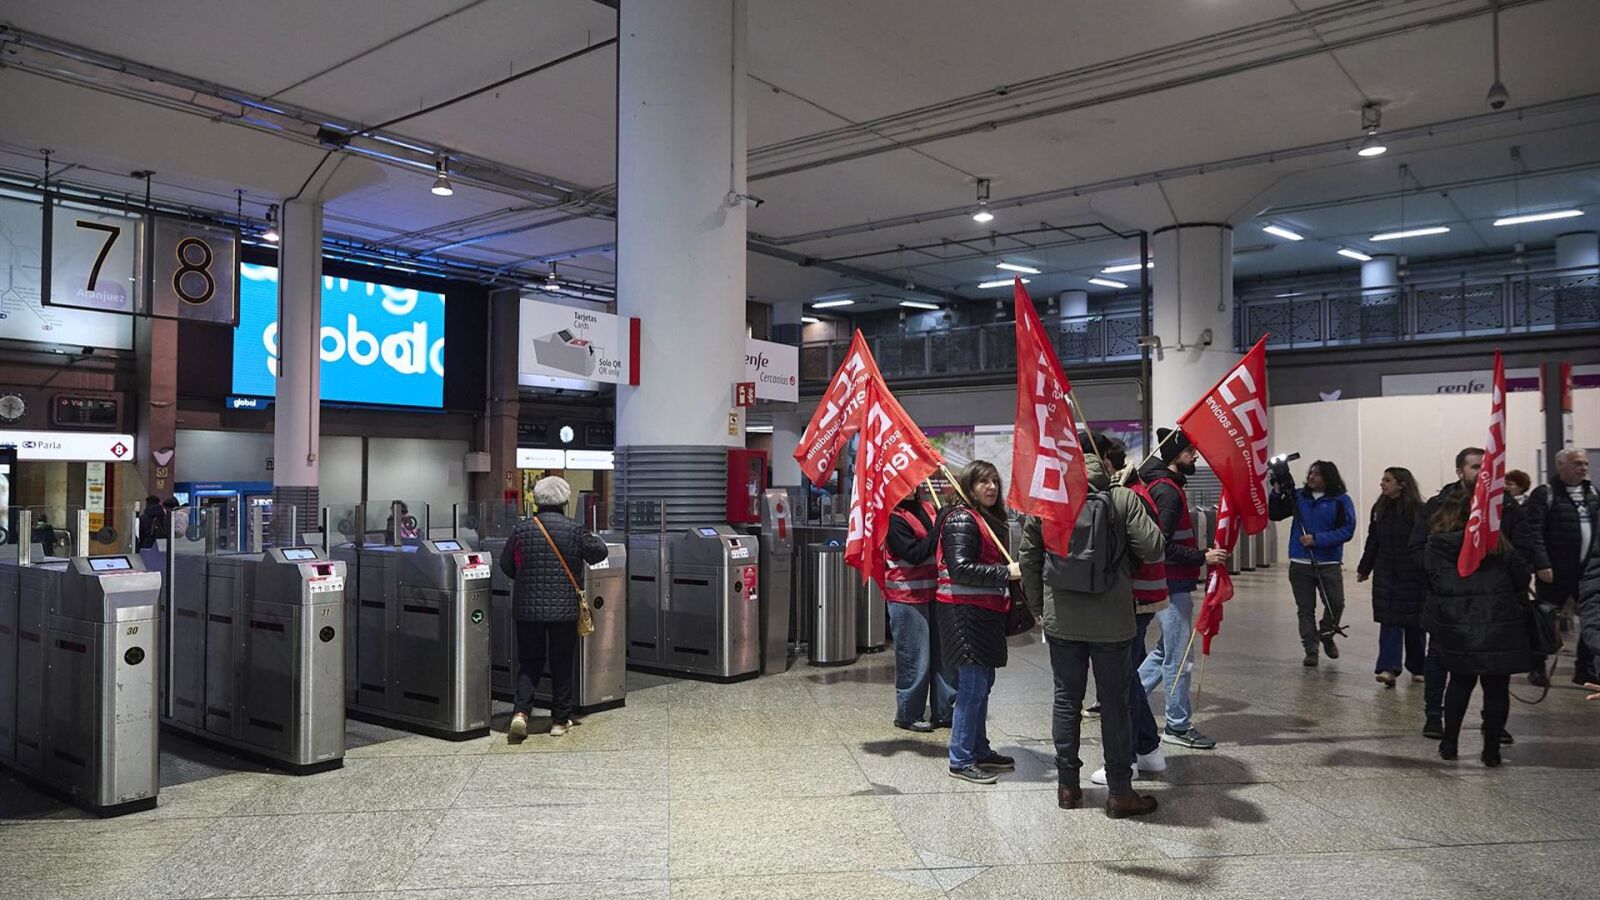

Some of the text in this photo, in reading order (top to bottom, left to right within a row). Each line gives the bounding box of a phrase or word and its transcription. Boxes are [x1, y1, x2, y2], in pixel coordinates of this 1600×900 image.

[76, 220, 120, 291] 7
[173, 236, 216, 305] 8
[76, 287, 126, 303] Aranjuez
[574, 312, 597, 323] Tarjetas
[573, 320, 590, 330] Cards
[599, 359, 622, 369] Solo QR
[745, 352, 769, 371] enfe
[598, 366, 620, 378] QR only
[1436, 379, 1485, 394] renfe
[233, 398, 257, 408] global
[1206, 395, 1232, 433] ervicios
[1228, 426, 1237, 438] a
[1235, 435, 1246, 449] la
[38, 441, 62, 450] Parla
[114, 443, 124, 455] 8
[321, 608, 331, 617] 31
[126, 626, 139, 636] 30
